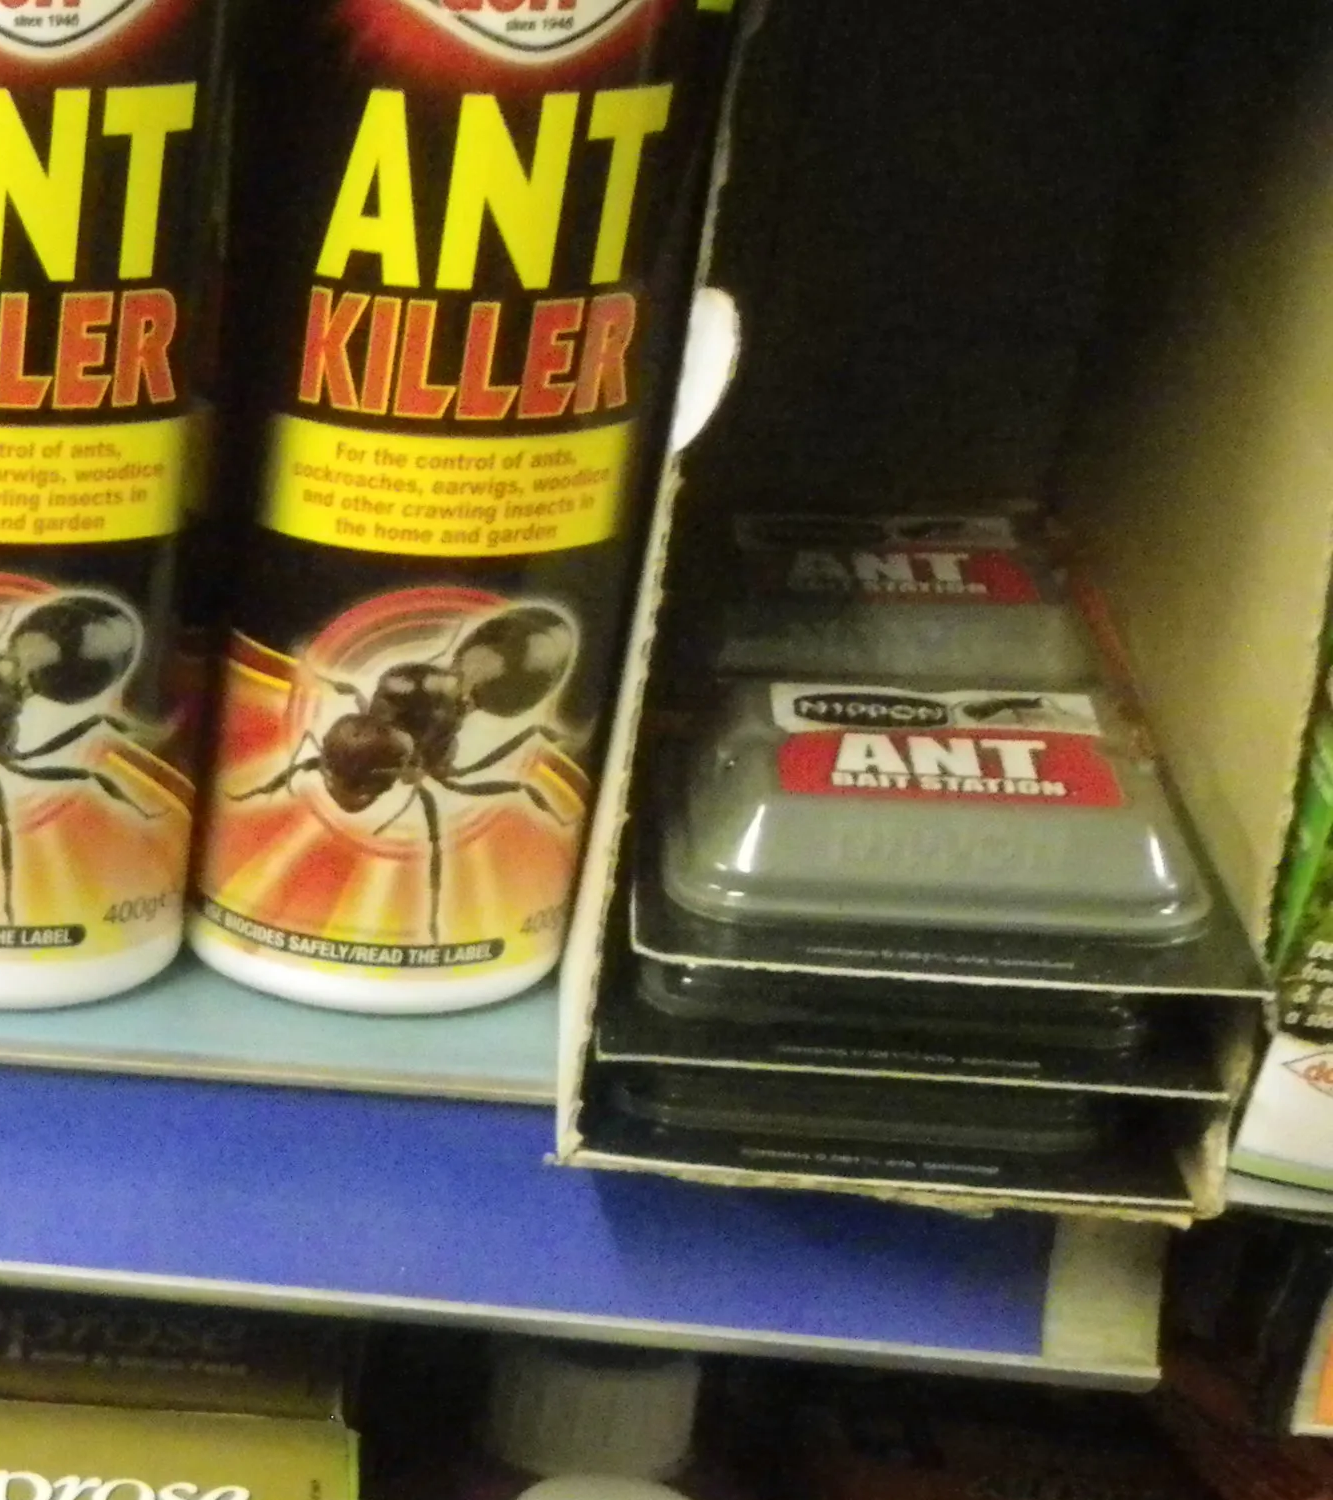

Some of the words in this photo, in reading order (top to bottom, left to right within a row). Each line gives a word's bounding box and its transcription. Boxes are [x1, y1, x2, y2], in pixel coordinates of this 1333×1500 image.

[314, 82, 674, 291] ANT
[298, 285, 637, 421] KILLER
[335, 441, 367, 462] For
[373, 447, 409, 468] the
[414, 453, 496, 472] control
[502, 450, 524, 470] of
[302, 488, 335, 508] and
[341, 492, 395, 517] other
[401, 501, 498, 526] crawling
[504, 495, 576, 519] insects
[335, 517, 367, 537] the
[374, 521, 435, 544] home
[440, 524, 481, 546] and
[486, 521, 559, 548] garden
[787, 549, 971, 582] ANT
[834, 732, 1048, 780] ANT
[831, 770, 910, 790] BAIT
[919, 775, 1070, 797] STATION
[226, 914, 286, 950] BIOCIDES
[407, 949, 440, 966] THE
[444, 939, 495, 964] LABEL
